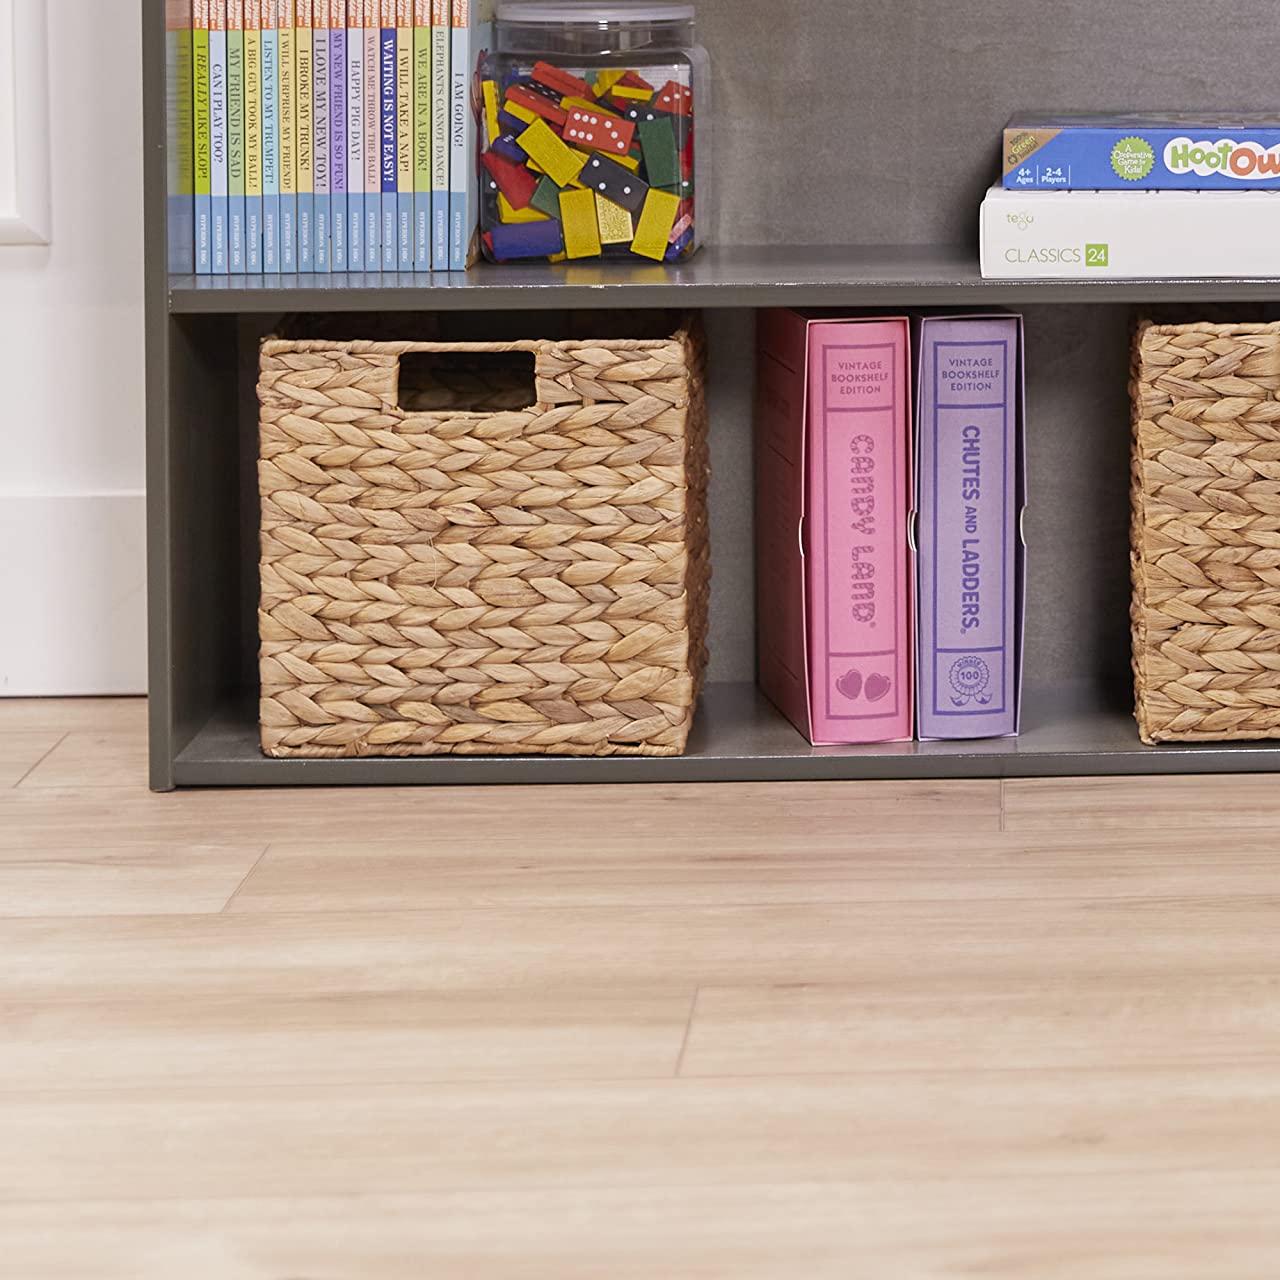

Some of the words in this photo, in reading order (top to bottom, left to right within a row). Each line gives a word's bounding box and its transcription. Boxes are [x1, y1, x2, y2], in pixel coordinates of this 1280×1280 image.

[281, 40, 290, 67] WILL
[334, 33, 342, 51] MY
[367, 36, 375, 72] WATCH
[229, 48, 240, 70] MY
[247, 49, 256, 69] BIG
[264, 40, 272, 82] LISTEN
[316, 48, 326, 86] LOVE
[334, 54, 342, 81] NEW
[384, 40, 393, 95] WAITING
[418, 48, 426, 68] WE
[435, 31, 444, 95] ELEPHANTS
[197, 54, 206, 105] REALLY
[213, 64, 222, 91] CAN
[248, 72, 256, 95] GUY
[300, 57, 308, 99] BROKE
[351, 60, 360, 102] HAPPY
[367, 75, 375, 90] ME
[399, 56, 408, 89] WILL
[418, 73, 426, 99] ARE
[230, 74, 240, 127] FRIEND
[264, 84, 273, 100] TO
[282, 70, 290, 123] SURPRISE
[316, 90, 326, 114] MY
[455, 81, 463, 99] AM
[213, 100, 222, 130] PLAY
[248, 98, 256, 130] TOOK
[264, 104, 273, 120] MY
[300, 104, 309, 121] MY
[334, 84, 343, 127] FRIEND
[351, 106, 360, 127] PIG
[367, 94, 376, 130] THROW
[384, 99, 393, 110] IS
[400, 92, 408, 127] TAKE
[418, 103, 427, 115] IN
[197, 109, 207, 140] LIKE
[384, 115, 393, 141] NOT
[436, 98, 444, 142] CANNOT
[454, 104, 463, 147] GOING!
[230, 132, 240, 145] IS
[248, 133, 256, 151] MY
[282, 127, 290, 143] MY
[300, 124, 309, 171] TRUNK!
[316, 119, 326, 149] NEW
[334, 131, 343, 141] IS
[351, 131, 360, 161] DAY!
[367, 133, 376, 153] THE
[197, 144, 207, 179] SLOP!
[213, 133, 223, 163] TOO?
[264, 124, 273, 184] TRUMPET!
[334, 145, 343, 160] SO
[400, 143, 409, 172] NAP!
[418, 132, 427, 171] BOOK!
[1112, 151, 1152, 161] Cooperative
[1125, 144, 1132, 152] A
[230, 149, 241, 178] SAD
[248, 154, 257, 188] BALL!
[282, 145, 291, 189] FRIEND!
[316, 154, 326, 188] TOY!
[334, 163, 343, 189] FUN!
[368, 156, 376, 184] BALL!
[384, 144, 393, 181] EASY!
[436, 146, 444, 186] DANCE!
[1018, 167, 1031, 176] 4+
[1046, 167, 1062, 176] 2-4
[1118, 158, 1138, 167] Game
[1124, 165, 1143, 174] Kids!
[1016, 176, 1033, 184] Ages
[1041, 176, 1066, 184] Players
[1005, 248, 1081, 262] CLASSICS
[1088, 248, 1106, 262] 24
[838, 361, 882, 370] VINTAGE
[942, 370, 1000, 380] BOOKSHELF
[949, 358, 993, 367] VINTAGE
[831, 372, 889, 382] BOOKSHELF
[840, 385, 881, 395] EDITION
[951, 382, 992, 391] EDITION
[961, 425, 981, 500] CHUTES
[964, 505, 977, 533] AND
[961, 538, 980, 630] LADDERS
[960, 671, 979, 680] 100
